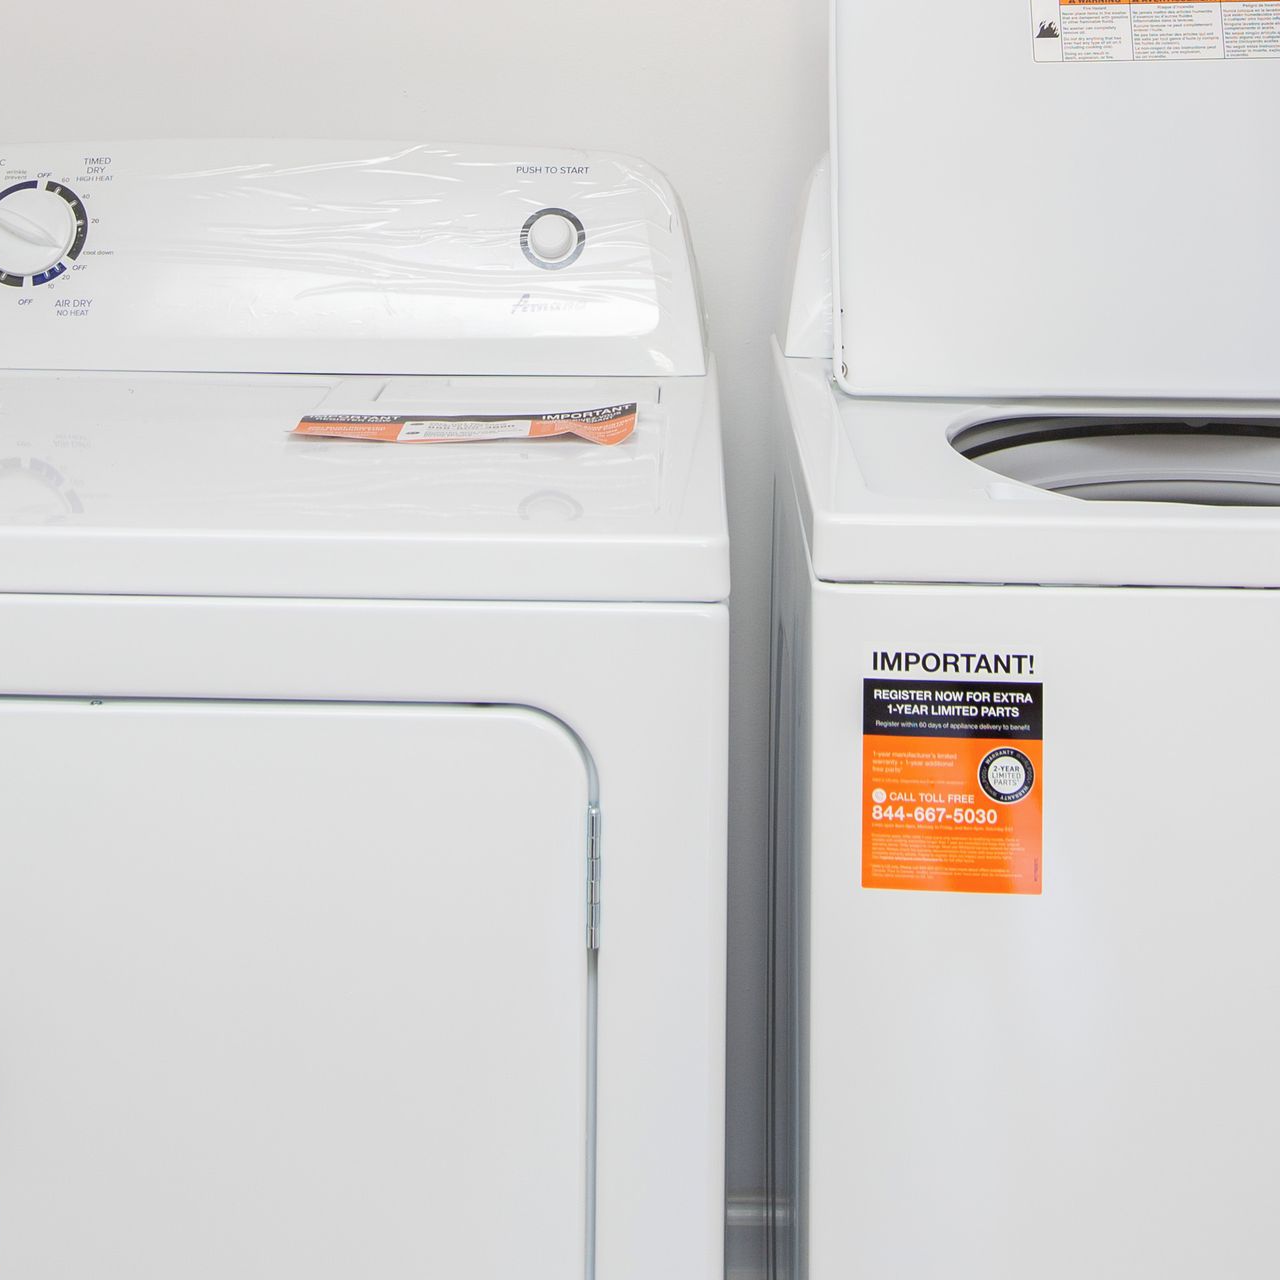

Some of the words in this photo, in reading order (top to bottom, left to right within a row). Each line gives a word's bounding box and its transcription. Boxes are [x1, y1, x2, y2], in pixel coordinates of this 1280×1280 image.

[83, 157, 112, 165] TIMED
[36, 171, 53, 179] OFF
[86, 166, 106, 175] DRY
[516, 166, 542, 174] PUSH
[545, 166, 558, 174] TO
[560, 166, 590, 175] START
[17, 298, 34, 306] OFF
[54, 299, 71, 308] AIR
[72, 299, 93, 308] DRY
[56, 309, 68, 317] NO
[69, 309, 89, 317] HEAT
[542, 404, 632, 421] IMPORTANT
[872, 651, 1034, 675] IMPORTANT!
[873, 689, 932, 701] REGISTER
[934, 691, 964, 703] NOW
[966, 691, 991, 703] FOR
[993, 692, 1034, 704] EXTRA
[887, 703, 929, 716] 1-YEAR
[931, 705, 979, 717] LIMITED
[981, 706, 1020, 718] PARTS
[875, 720, 900, 728] Register
[918, 721, 927, 729] 60
[927, 722, 942, 730] days
[949, 722, 979, 731] appliance
[979, 723, 1002, 732] delivery
[1009, 723, 1031, 732] benefit
[985, 749, 1015, 765] WARRANTY
[889, 791, 916, 803] CALL
[918, 792, 945, 804] TOLL
[947, 793, 975, 804] FREE
[871, 805, 998, 825] 844-667-5030
